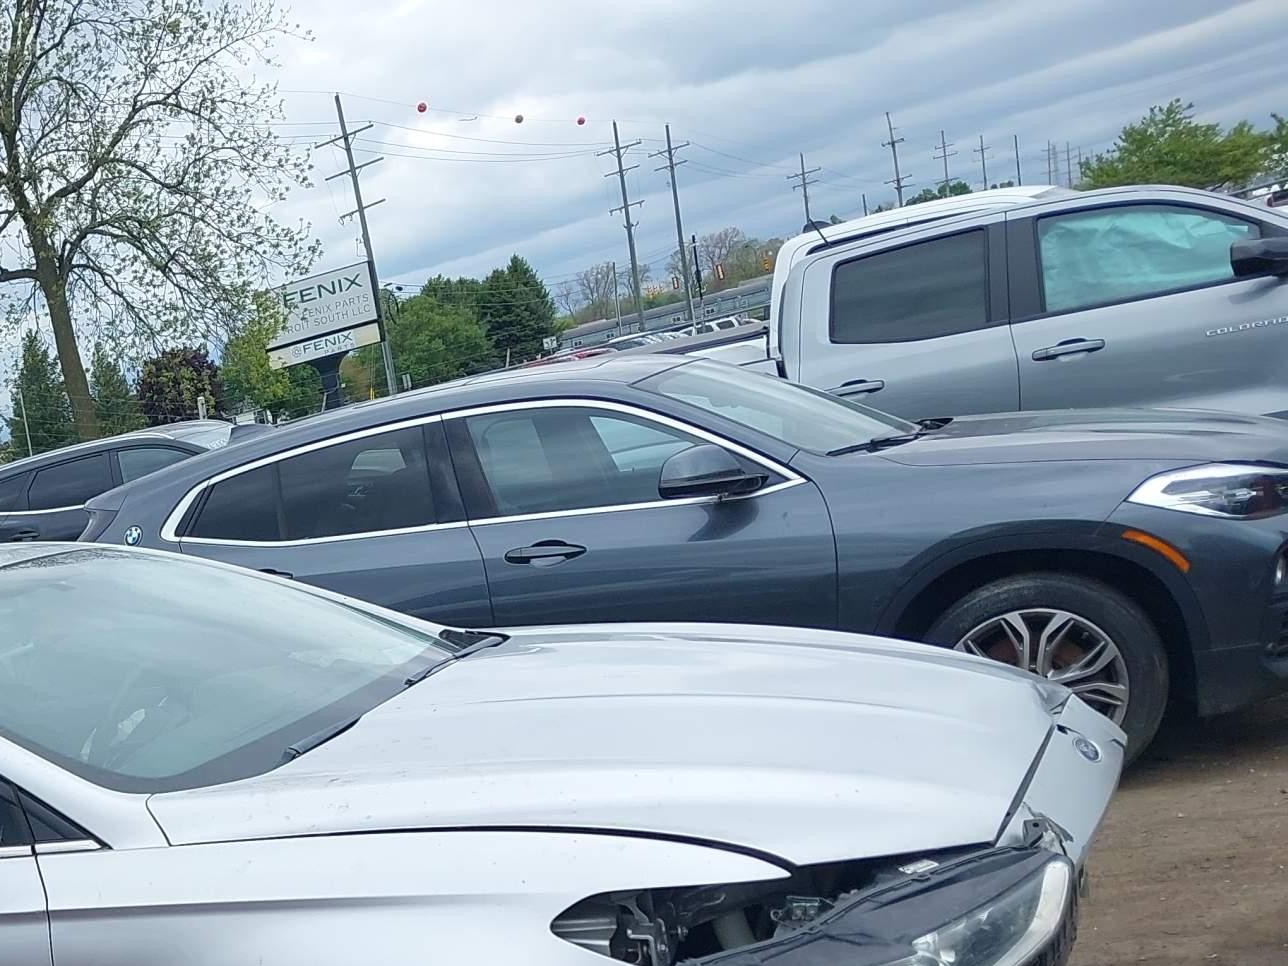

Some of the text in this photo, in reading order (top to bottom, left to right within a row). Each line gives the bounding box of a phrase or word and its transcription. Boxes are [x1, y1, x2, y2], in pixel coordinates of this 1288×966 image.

[283, 273, 363, 307] FENIX
[302, 294, 369, 318] FENIX PARTS
[314, 311, 349, 326] SOUTH
[352, 304, 371, 316] LLC
[302, 332, 353, 354] FENIX
